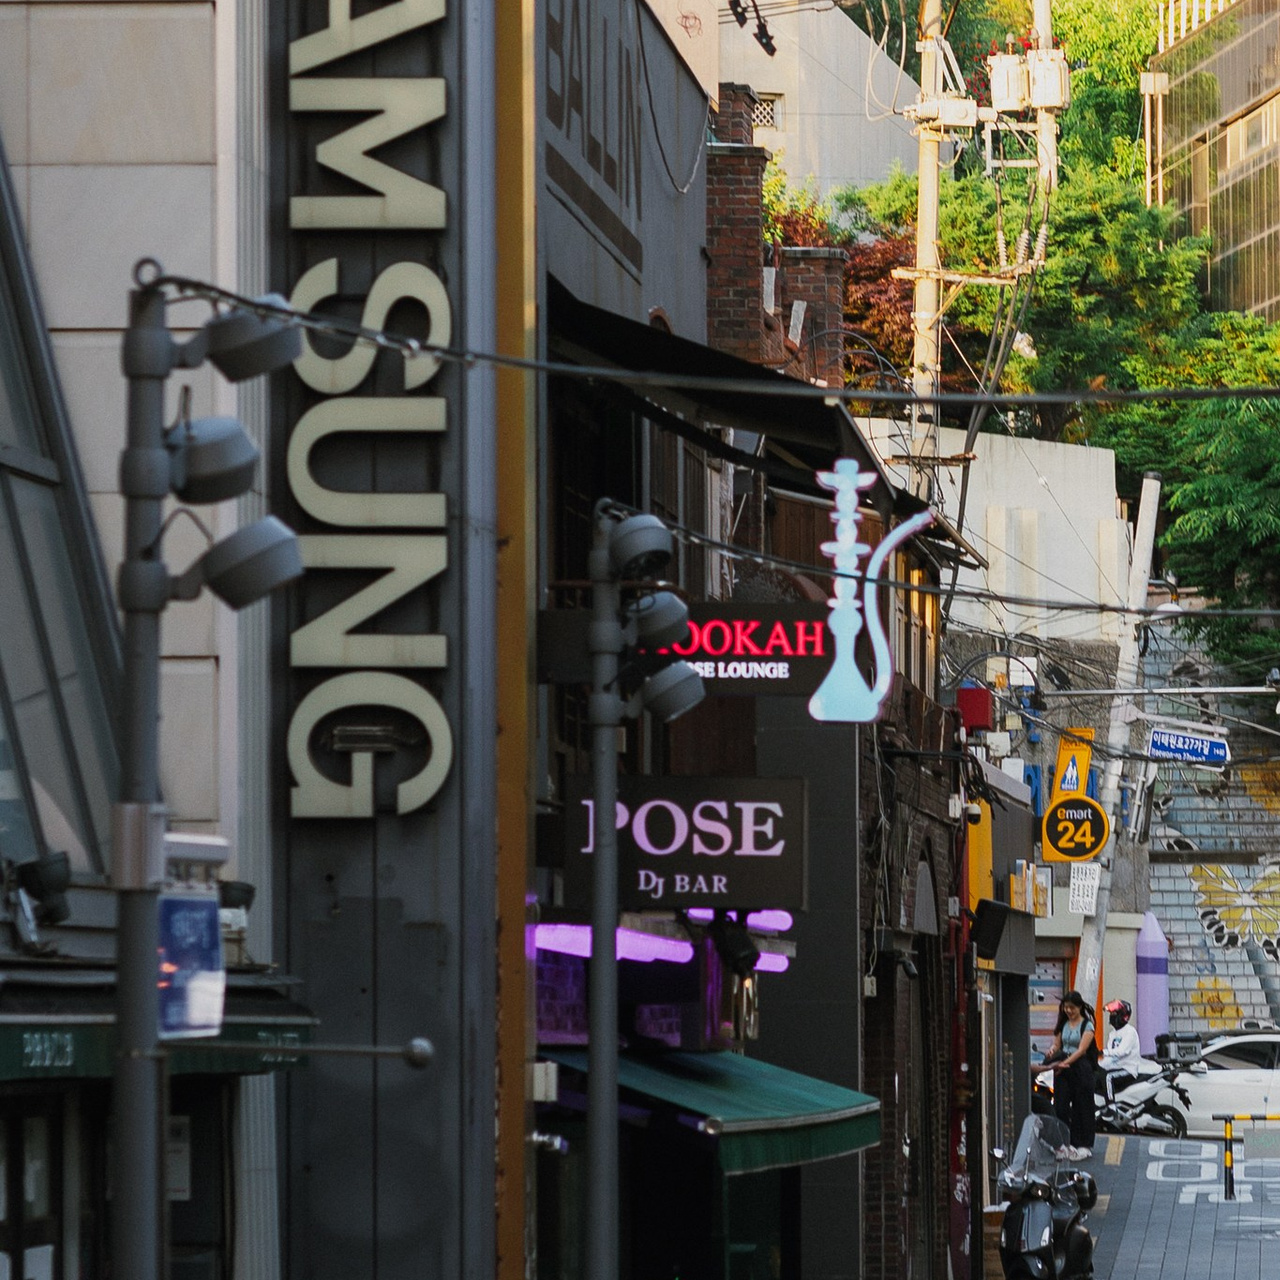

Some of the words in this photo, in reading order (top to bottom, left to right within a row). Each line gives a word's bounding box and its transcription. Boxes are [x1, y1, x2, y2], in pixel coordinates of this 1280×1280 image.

[638, 619, 826, 657] OOKAH
[717, 661, 790, 679] LOUNGE
[1056, 806, 1093, 820] emart
[1057, 821, 1096, 850] 24
[674, 874, 729, 895] BAR
